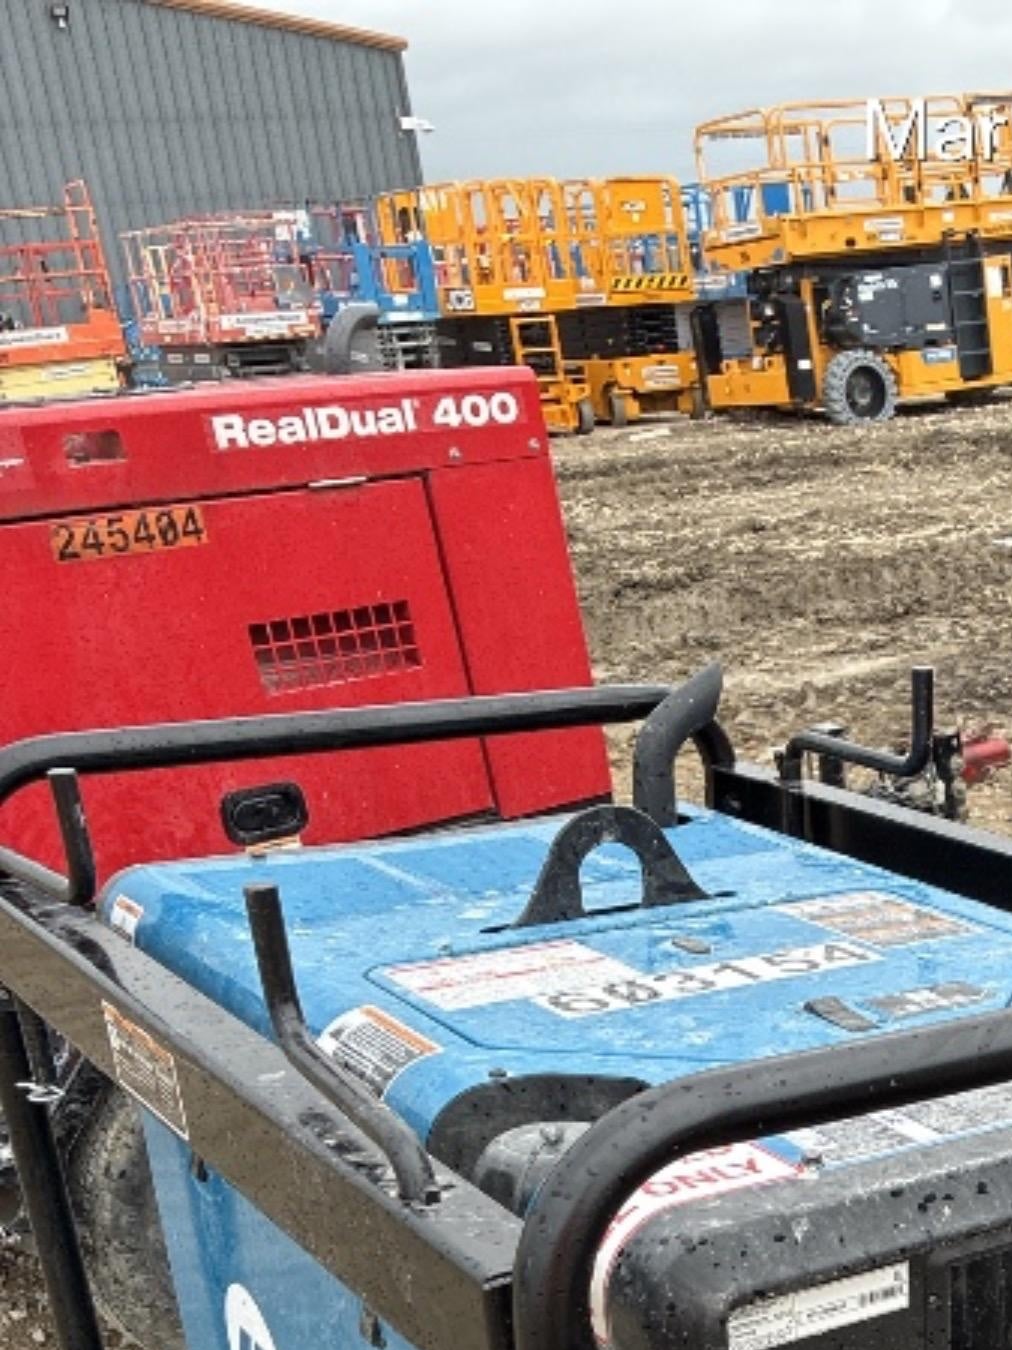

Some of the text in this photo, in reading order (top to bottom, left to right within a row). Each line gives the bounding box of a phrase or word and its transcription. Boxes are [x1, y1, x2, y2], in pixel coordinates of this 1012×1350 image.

[211, 392, 519, 450] RealDual 400
[640, 1156, 762, 1196] ONLY
